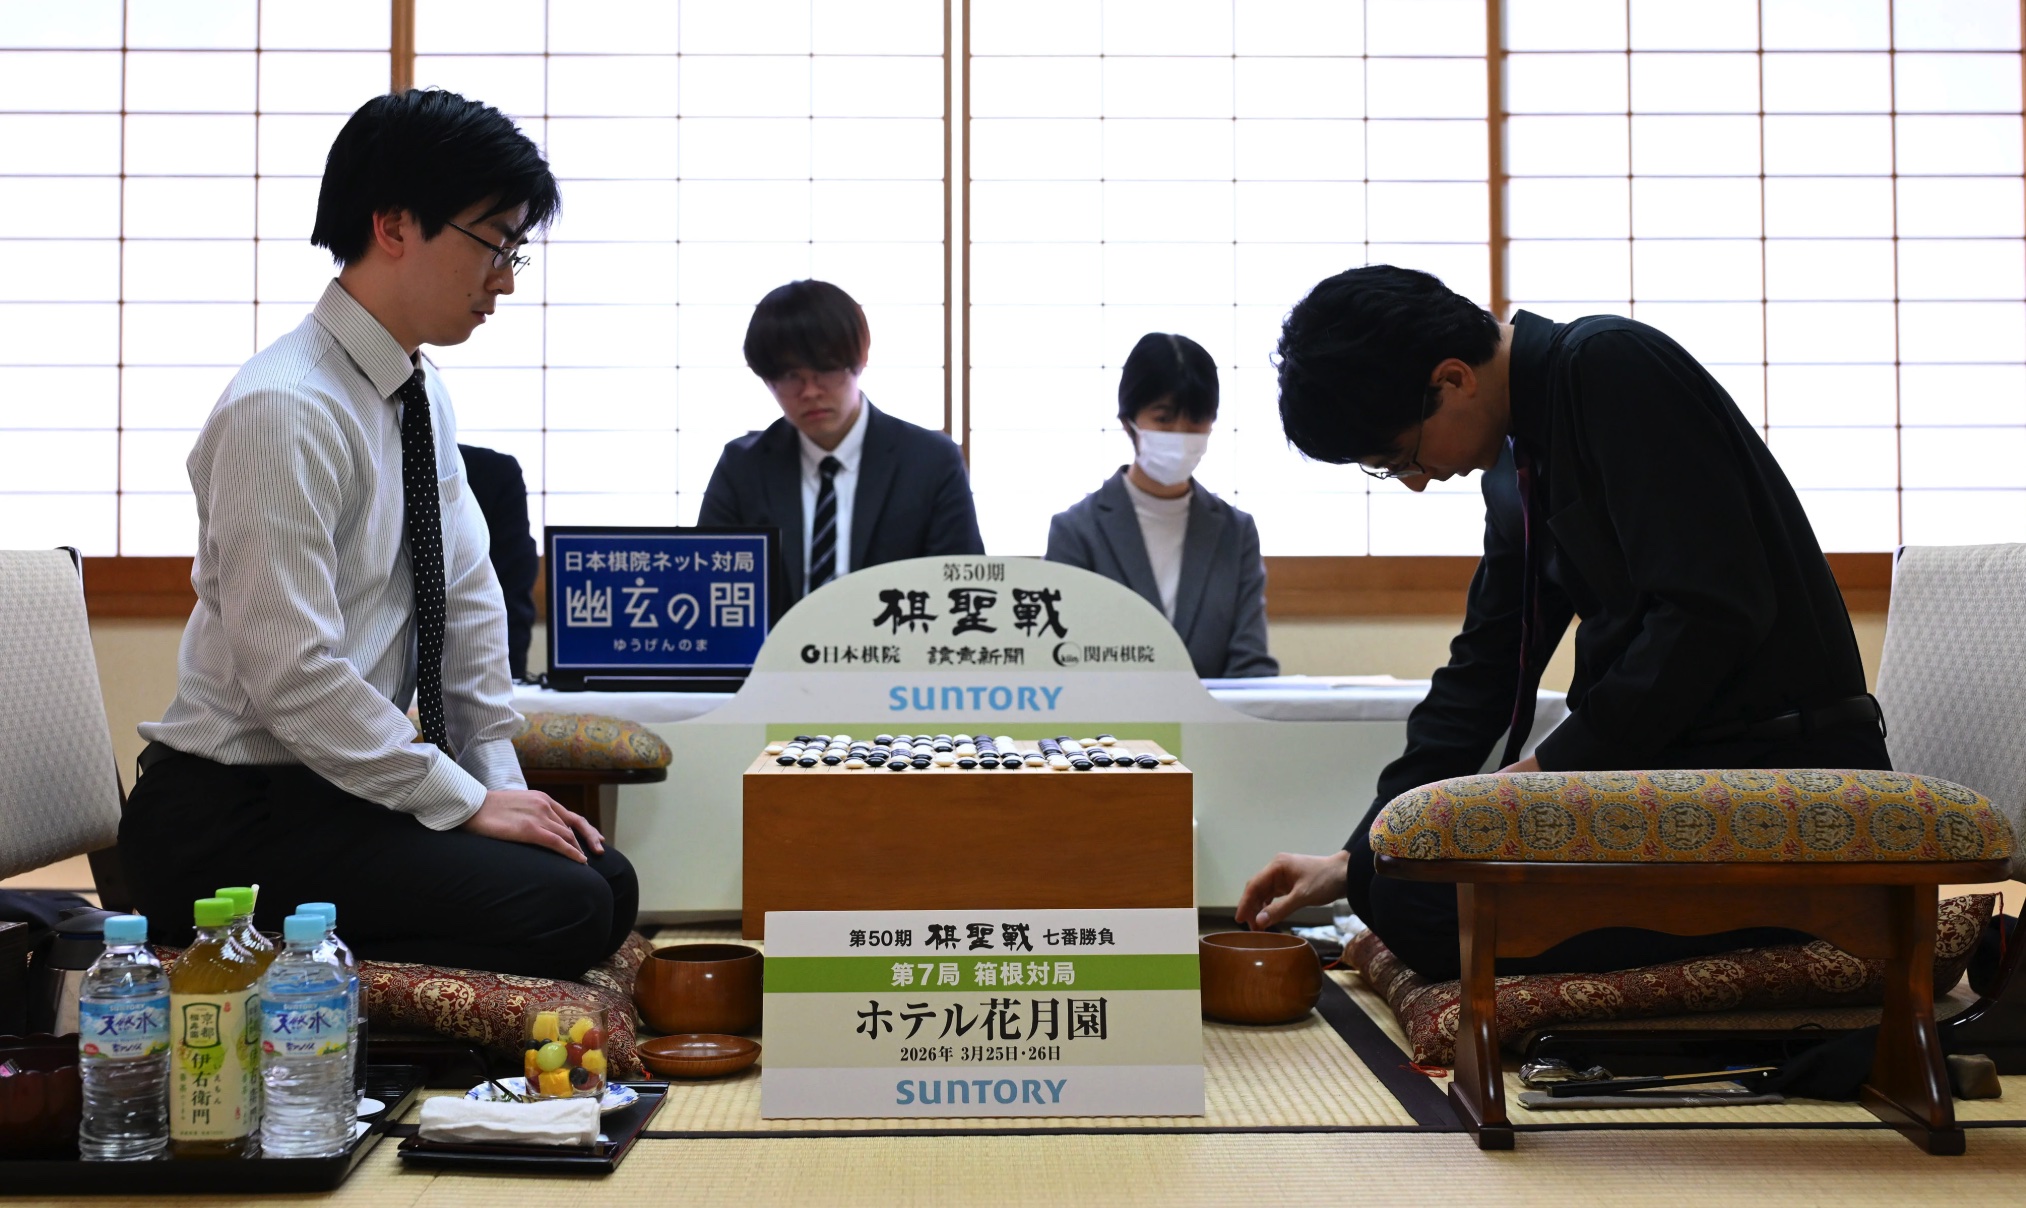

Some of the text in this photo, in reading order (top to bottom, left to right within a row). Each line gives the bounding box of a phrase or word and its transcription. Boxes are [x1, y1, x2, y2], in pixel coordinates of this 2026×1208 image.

[565, 551, 755, 573] 日本棋院ネット対局
[942, 563, 1005, 582] 第50期
[566, 578, 755, 630] 幽玄の間
[613, 638, 708, 652] ゆうげんのま
[823, 645, 901, 664] 日本棋院
[1083, 645, 1155, 663] 関西棋院
[889, 685, 1064, 712] SUNTORY
[848, 929, 913, 948] 第50期
[1042, 927, 1116, 946] 七番勝負
[890, 961, 1076, 987] 第7局 箱根対局
[97, 1012, 157, 1036] 天然水
[273, 1011, 332, 1034] 天然水
[855, 997, 1109, 1042] ホテル花月園
[900, 1045, 954, 1063] 2026年
[191, 1052, 212, 1125] 伊右衛門
[896, 1078, 1068, 1106] SUNTORY
